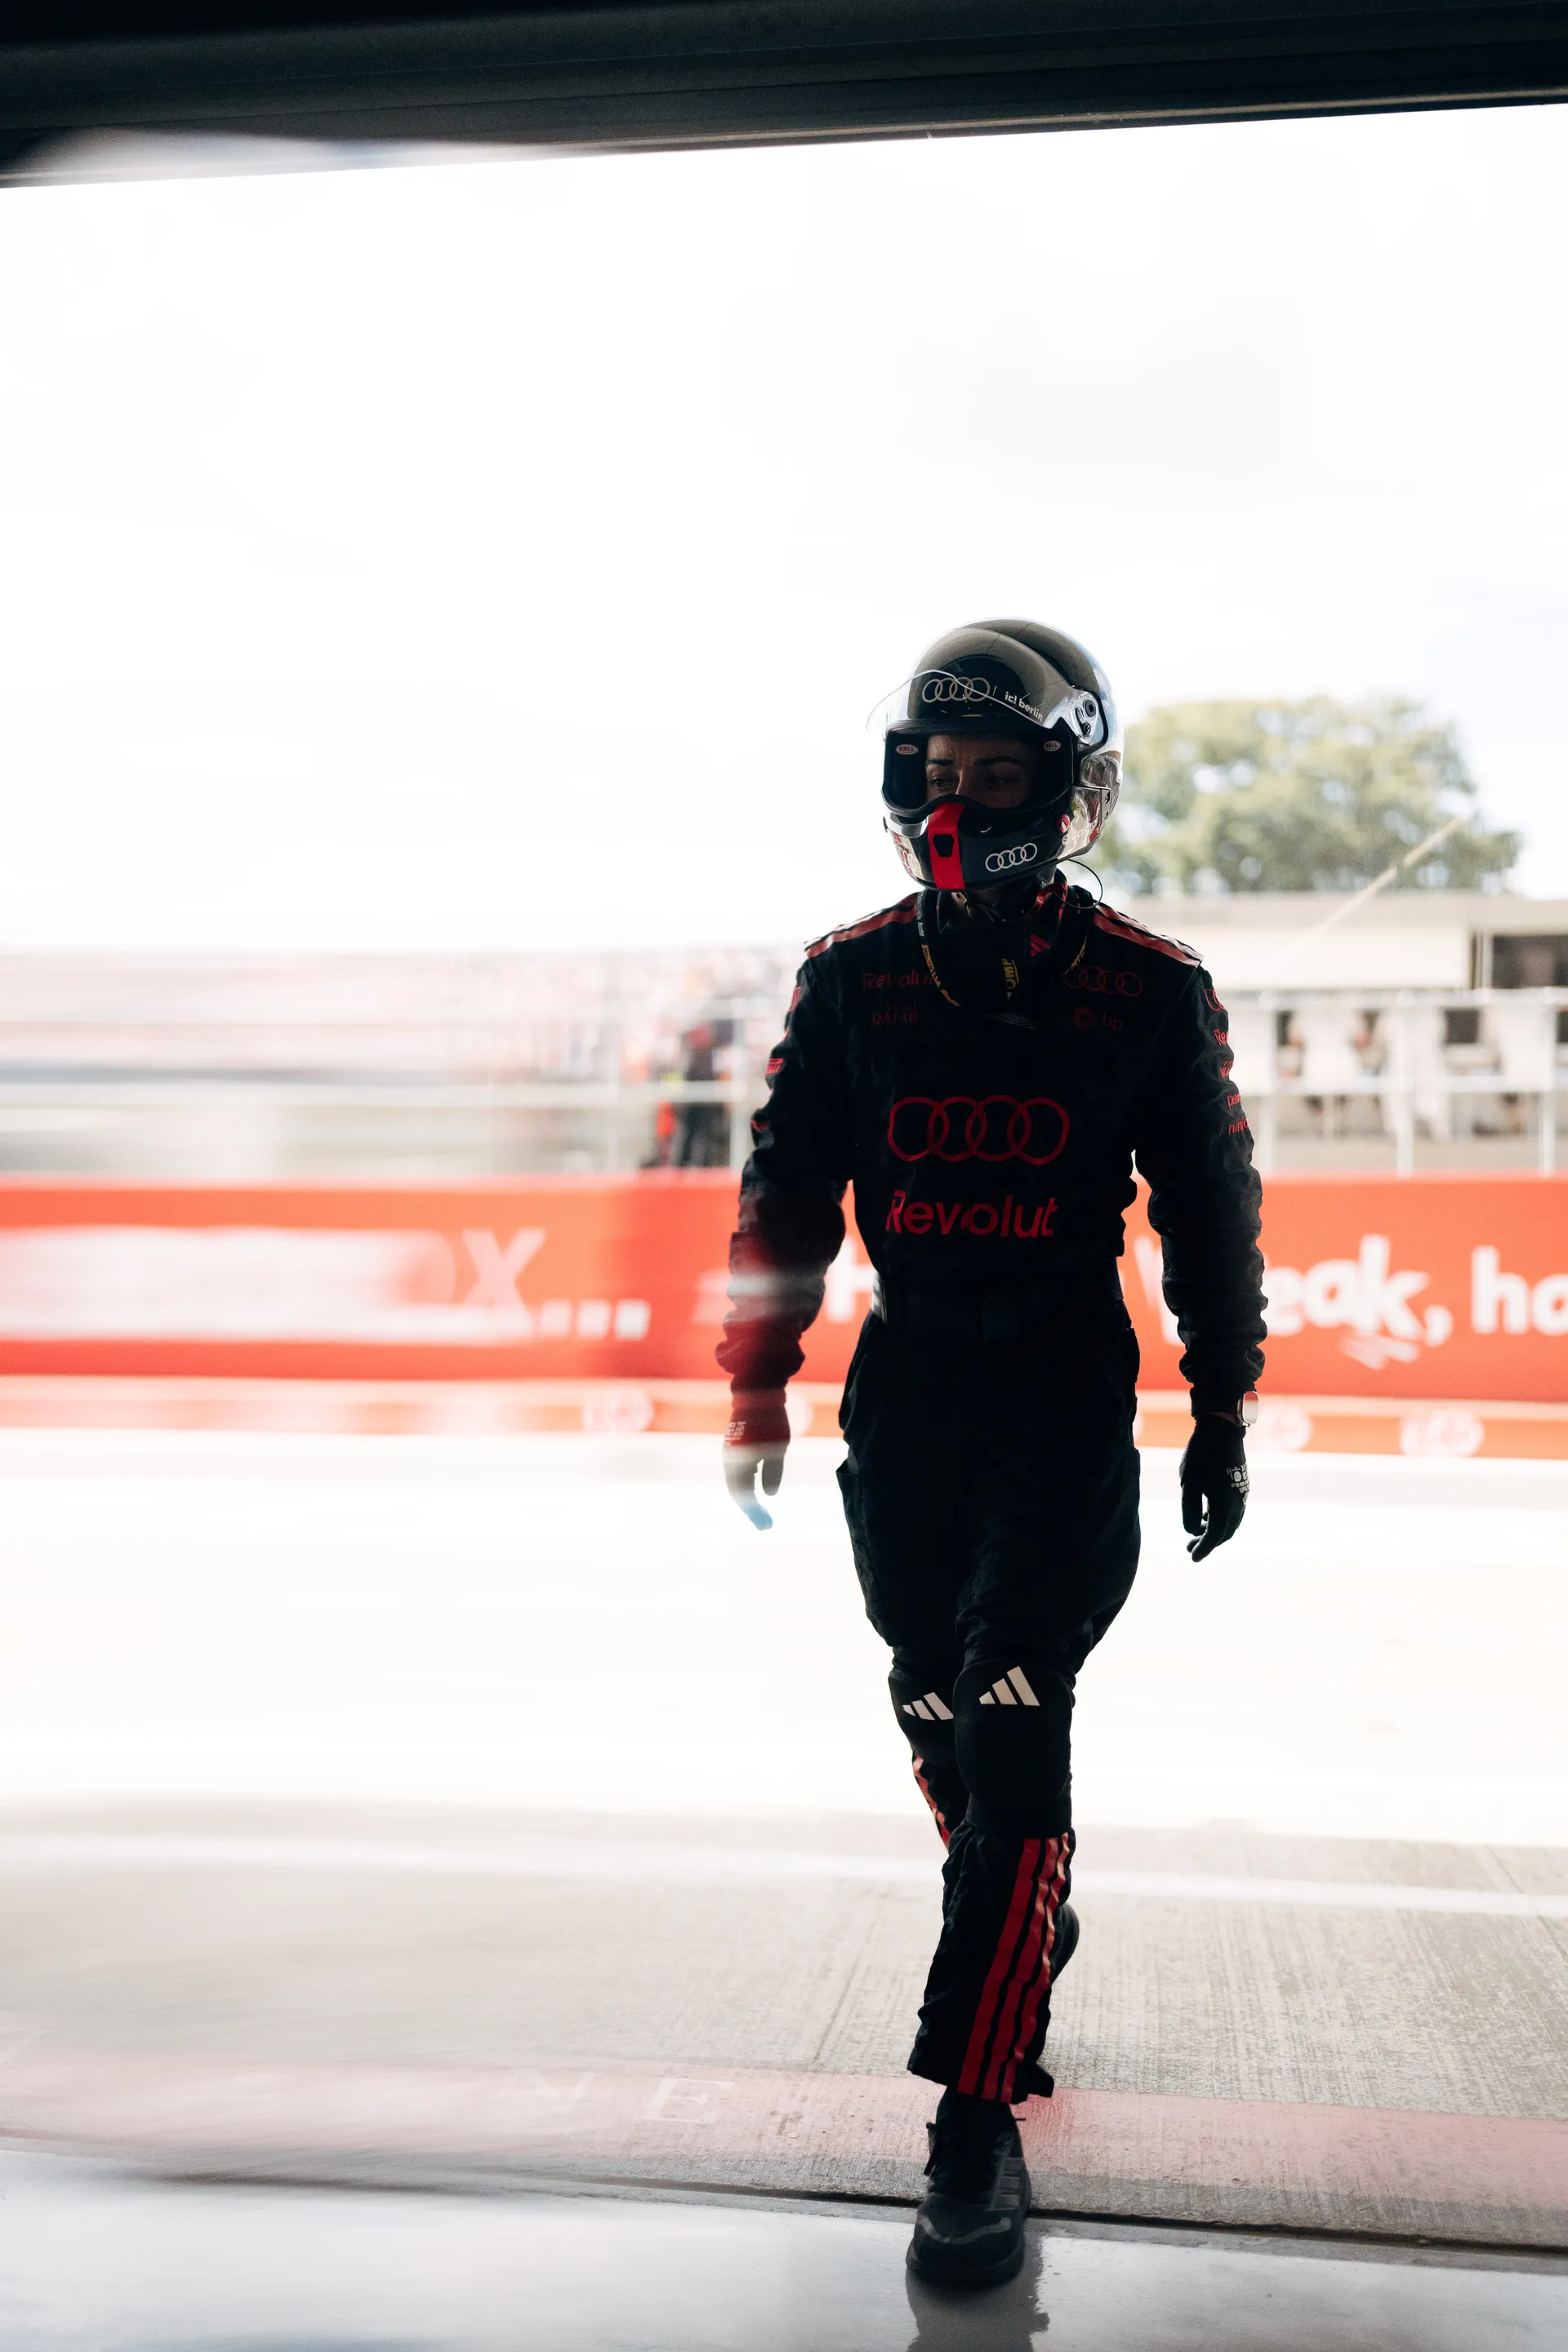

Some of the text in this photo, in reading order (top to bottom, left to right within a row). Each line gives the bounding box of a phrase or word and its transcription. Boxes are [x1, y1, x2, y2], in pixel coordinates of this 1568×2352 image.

[1018, 697, 1043, 722] berlin
[862, 968, 933, 991] Revolu
[872, 1012, 919, 1026] QATAR
[1102, 1013, 1124, 1033] bp
[885, 1189, 1059, 1239] Revolut
